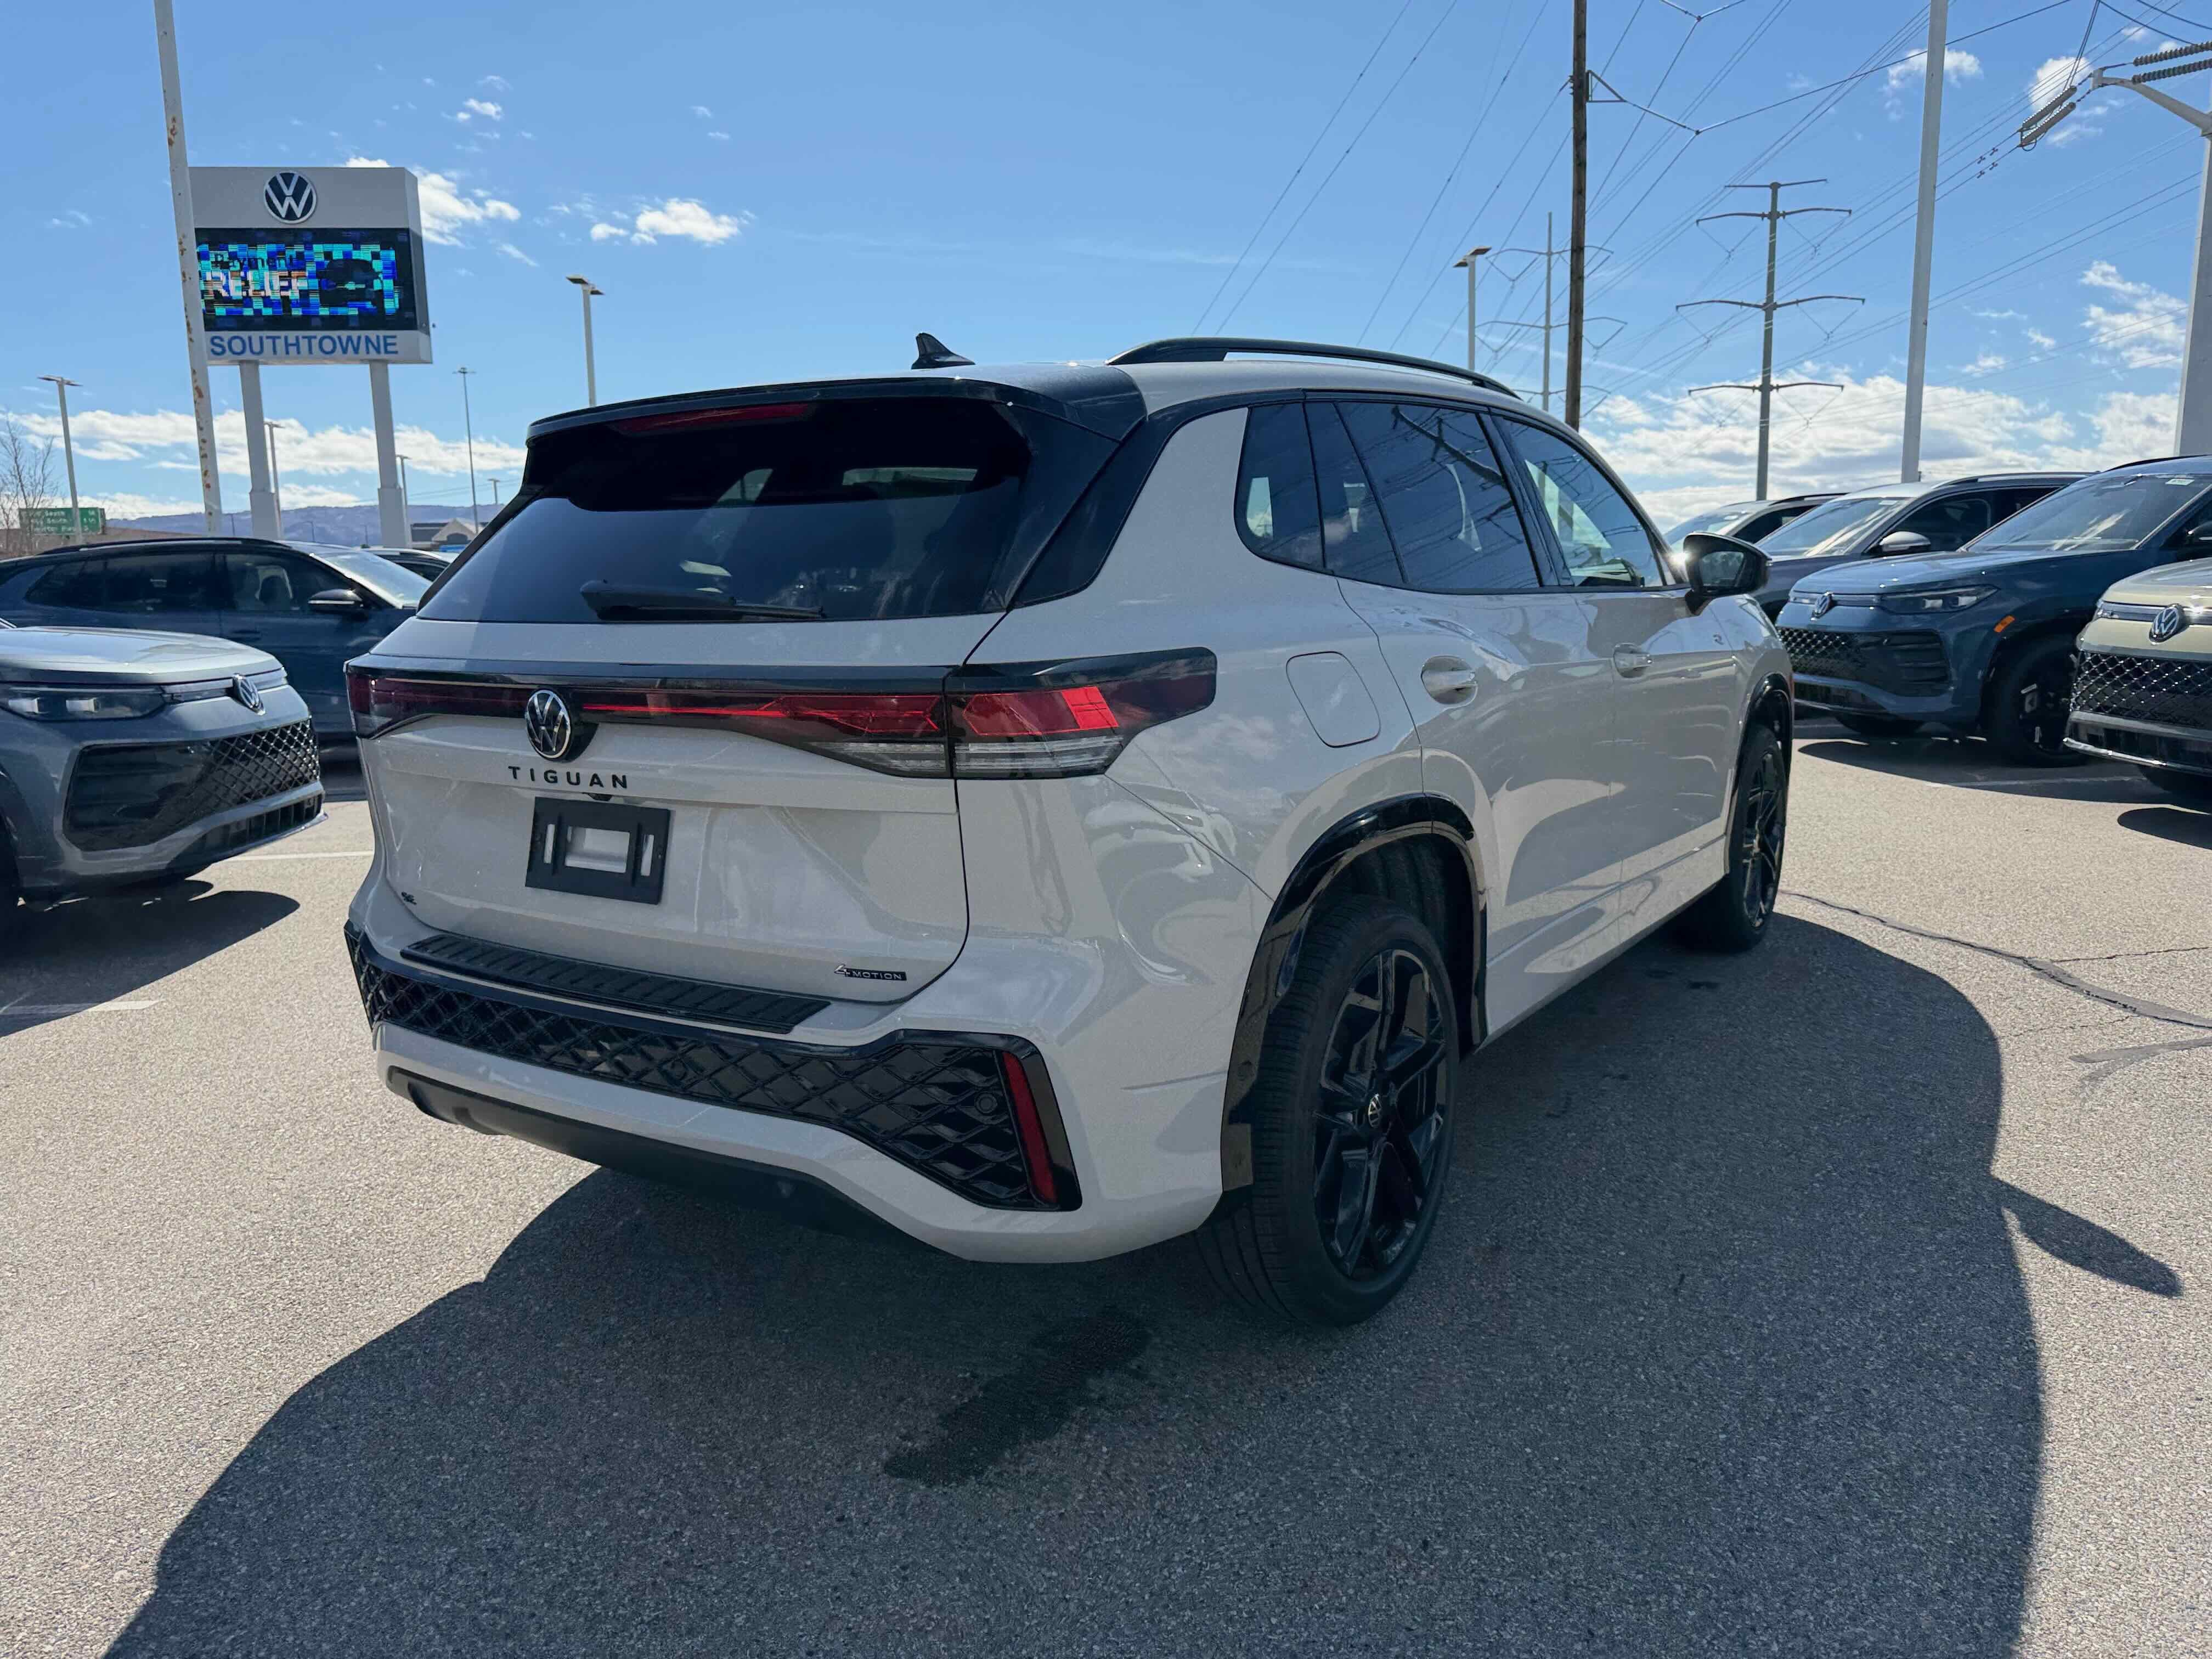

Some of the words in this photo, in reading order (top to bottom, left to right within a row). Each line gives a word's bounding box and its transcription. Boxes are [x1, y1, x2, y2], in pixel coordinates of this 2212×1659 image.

[210, 334, 399, 356] SOUTHTOWNE
[526, 690, 570, 758] VW
[508, 765, 628, 789] TIGUAN
[834, 963, 902, 979] 4MOTION
